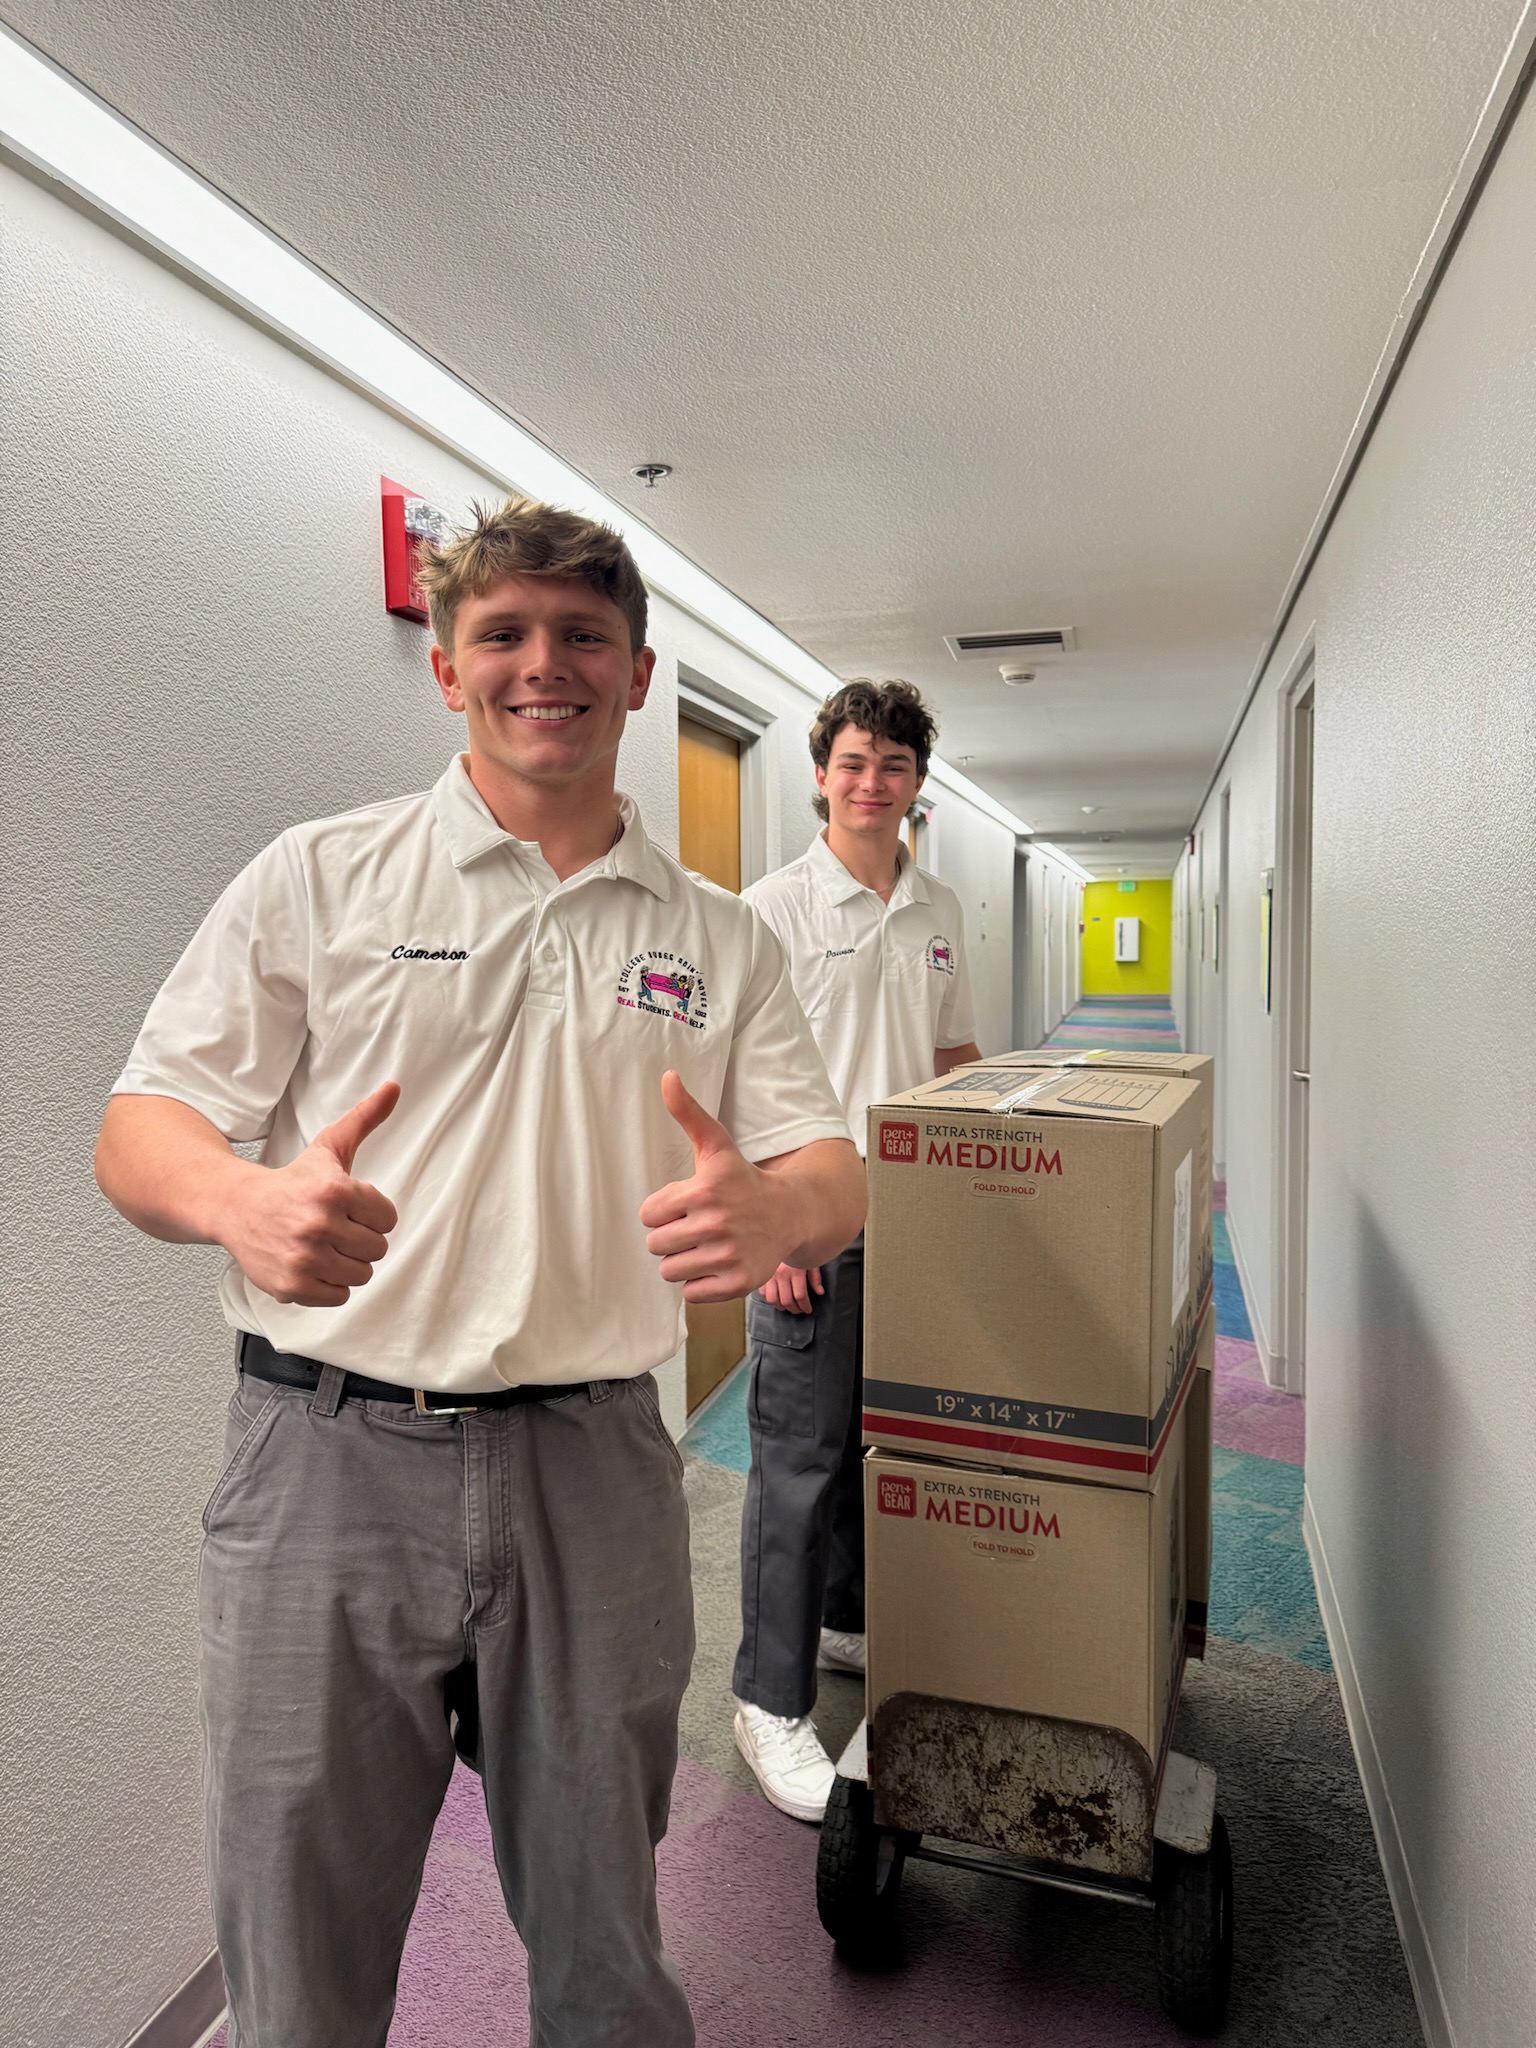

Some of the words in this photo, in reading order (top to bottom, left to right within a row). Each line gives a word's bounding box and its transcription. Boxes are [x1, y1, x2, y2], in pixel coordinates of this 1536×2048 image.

[391, 945, 471, 960] Cameron
[620, 953, 646, 984] COLLEGE
[697, 978, 708, 1008] MOVES
[617, 996, 636, 1008] REAL
[637, 1000, 672, 1018] STUDENTS.
[673, 1011, 688, 1024] REAL
[883, 1128, 915, 1144] pen+
[926, 1125, 968, 1138] EXTRA
[971, 1128, 1043, 1144] STRENGTH
[886, 1139, 913, 1156] GEAR
[926, 1140, 1063, 1175] MEDIUM
[974, 1182, 996, 1192] FOLD
[998, 1185, 1010, 1193] TO
[1011, 1186, 1036, 1195] HOLD
[971, 1404, 983, 1418] x
[1027, 1412, 1039, 1427] x
[881, 1481, 912, 1497] pen+
[924, 1480, 966, 1497] EXTRA
[969, 1487, 1041, 1506] STRENGTH
[884, 1492, 911, 1511] GEAR
[925, 1496, 1061, 1538] MEDIUM
[973, 1541, 995, 1551] FOLD
[997, 1543, 1009, 1553] TO
[1010, 1546, 1034, 1556] HOLD
